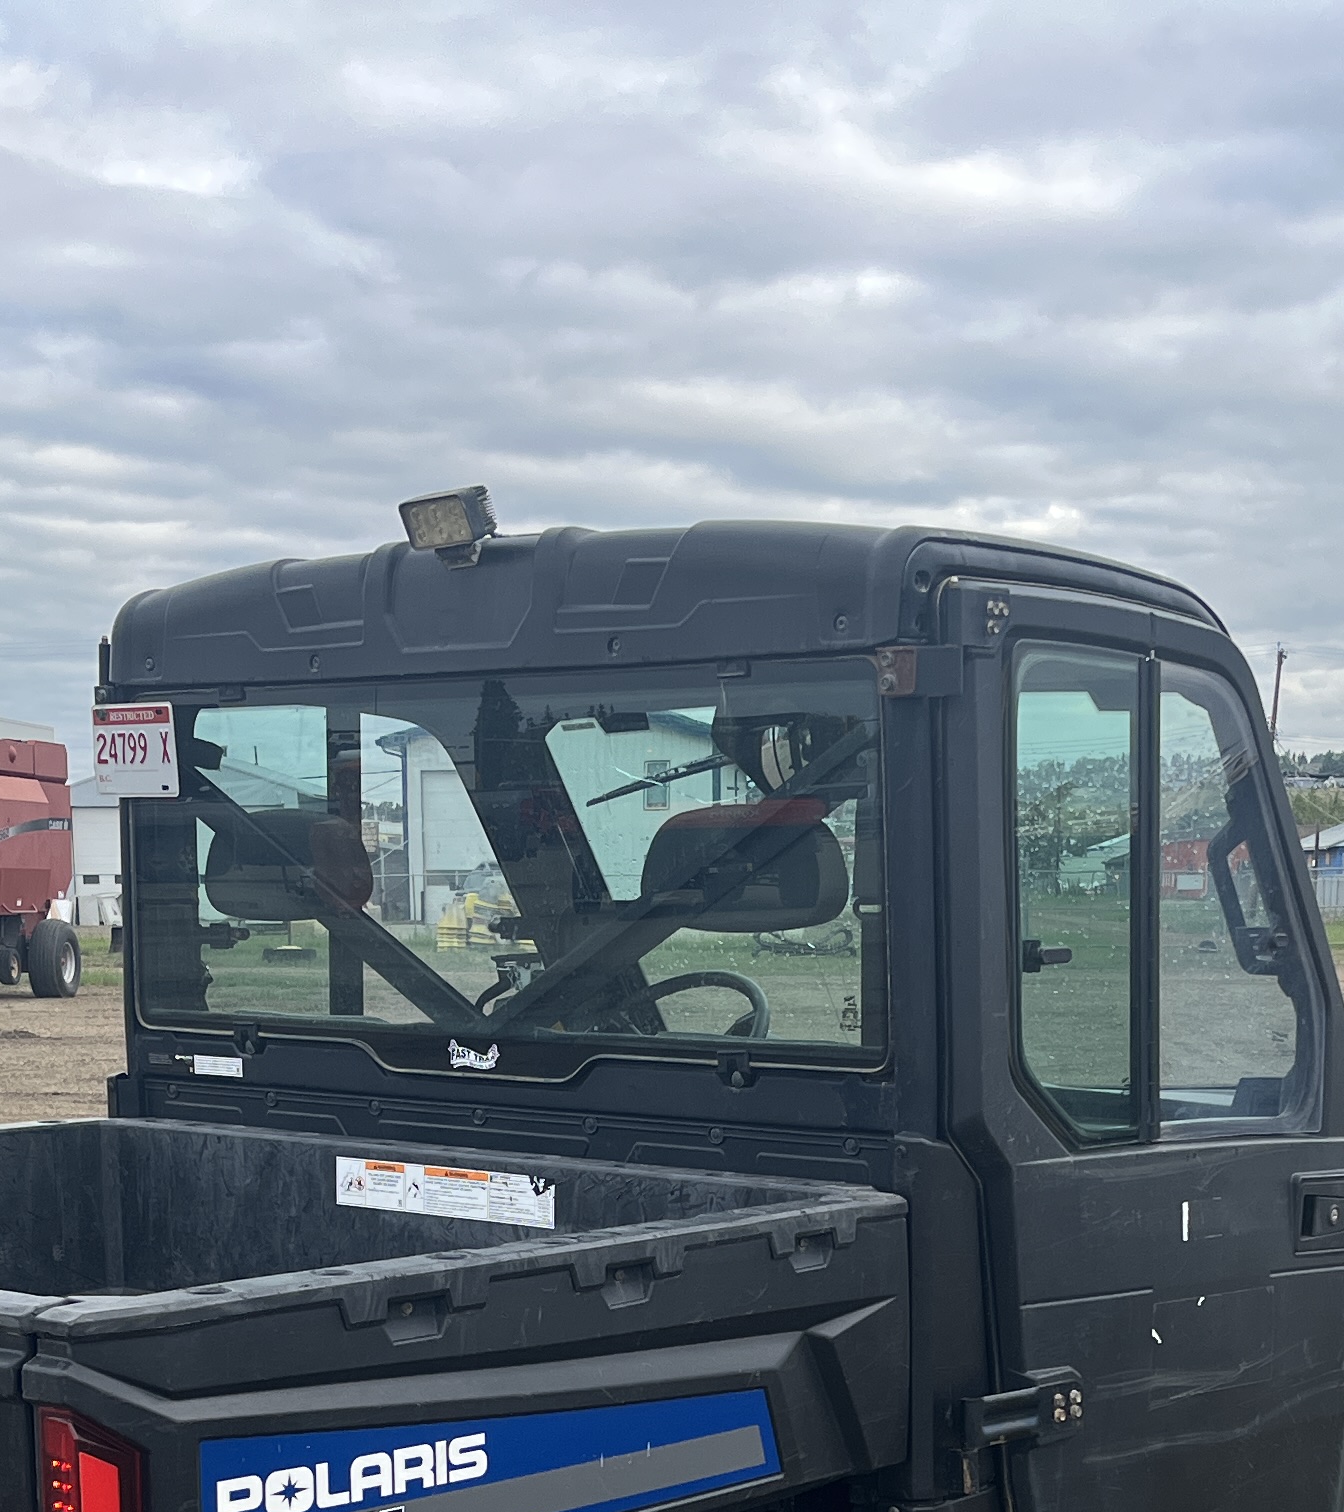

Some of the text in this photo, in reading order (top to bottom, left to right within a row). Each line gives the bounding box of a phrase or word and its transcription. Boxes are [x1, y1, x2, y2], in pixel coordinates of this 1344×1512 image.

[109, 711, 155, 722] RESTRICTED
[96, 731, 172, 765] 24799 X
